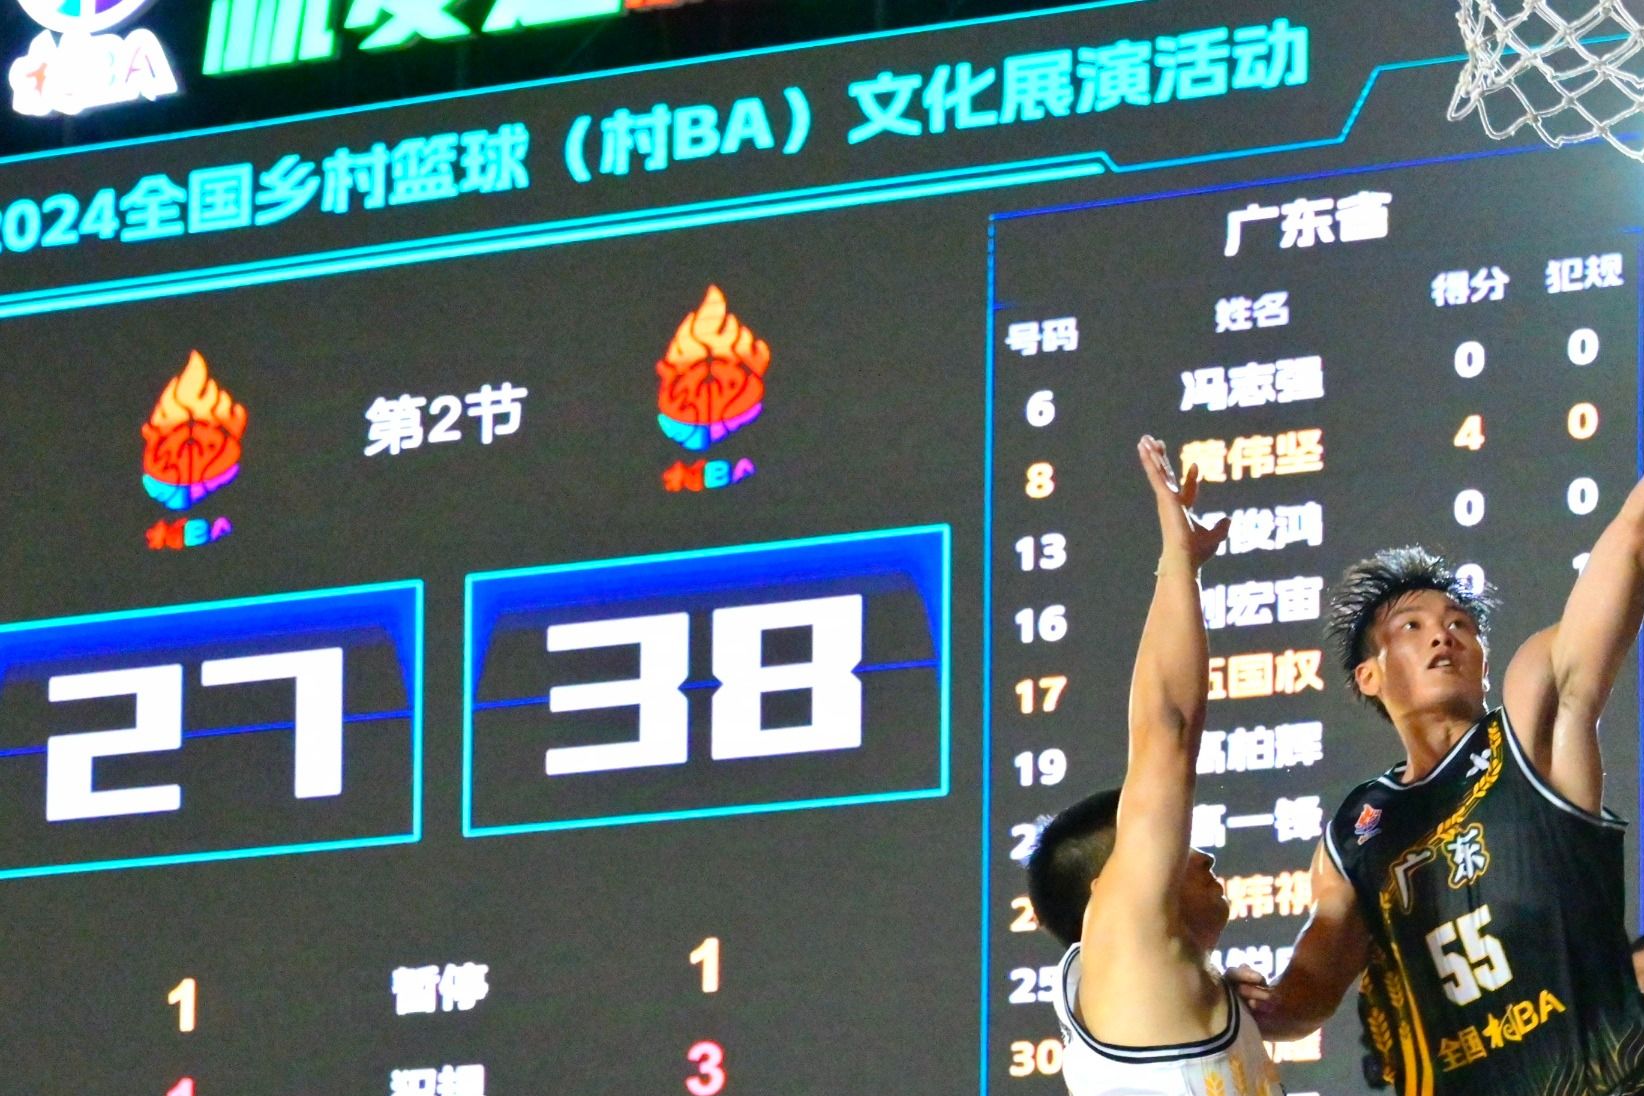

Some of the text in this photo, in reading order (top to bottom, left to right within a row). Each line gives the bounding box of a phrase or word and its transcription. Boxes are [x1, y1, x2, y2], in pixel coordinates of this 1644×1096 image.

[0, 19, 1309, 252] 024全国乡村篮球（村BA）文化展演活动
[1224, 190, 1392, 256] 广东省
[1004, 252, 1625, 357] 号码 姓名 得分 犯规
[1025, 390, 1056, 428] 6
[1454, 340, 1486, 379] 0
[1567, 328, 1600, 366] 0
[364, 382, 528, 457] 第2节
[1025, 462, 1055, 499] 8
[1454, 414, 1486, 450] 4
[1567, 403, 1599, 440] 0
[1015, 532, 1067, 571] 13
[1454, 488, 1486, 527] 0
[1567, 477, 1600, 516] 0
[1014, 605, 1068, 644] 16
[546, 594, 863, 775] 38
[1015, 675, 1068, 715] 17
[46, 647, 343, 821] 27
[1014, 748, 1068, 787] 19
[1010, 823, 1039, 861] 2
[1392, 825, 1488, 912] 广东
[1010, 896, 1039, 932] 2
[168, 936, 720, 1032] 1 暂停 1
[1009, 966, 1061, 1003] 25
[1425, 904, 1513, 1006] 55
[686, 1040, 727, 1096] 3
[1009, 1038, 1064, 1078] 30
